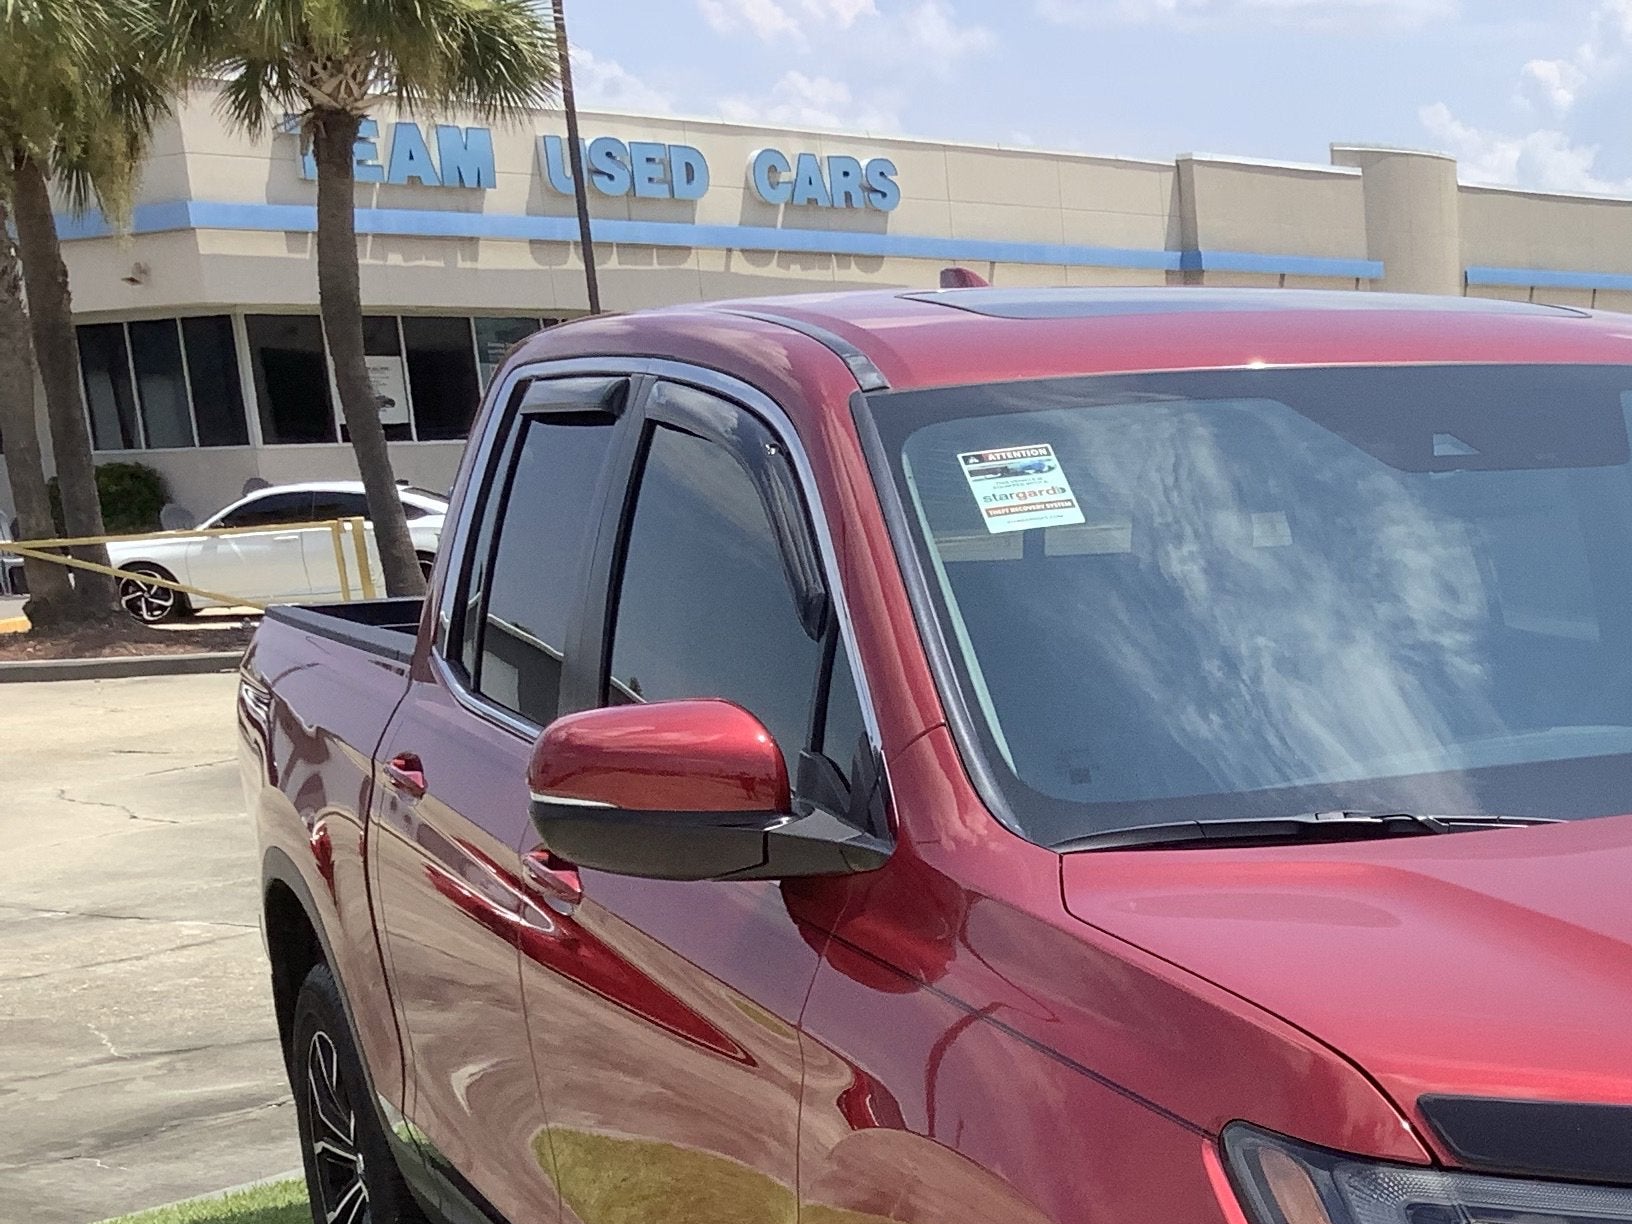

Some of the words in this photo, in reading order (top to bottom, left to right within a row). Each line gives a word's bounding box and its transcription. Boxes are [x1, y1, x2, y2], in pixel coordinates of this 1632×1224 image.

[537, 135, 709, 200] USED
[748, 148, 900, 212] CARS
[988, 448, 1048, 461] ATTENTION
[983, 486, 1056, 503] stargard
[1010, 503, 1045, 513] RECOVERY
[1046, 501, 1072, 509] SYSTEM
